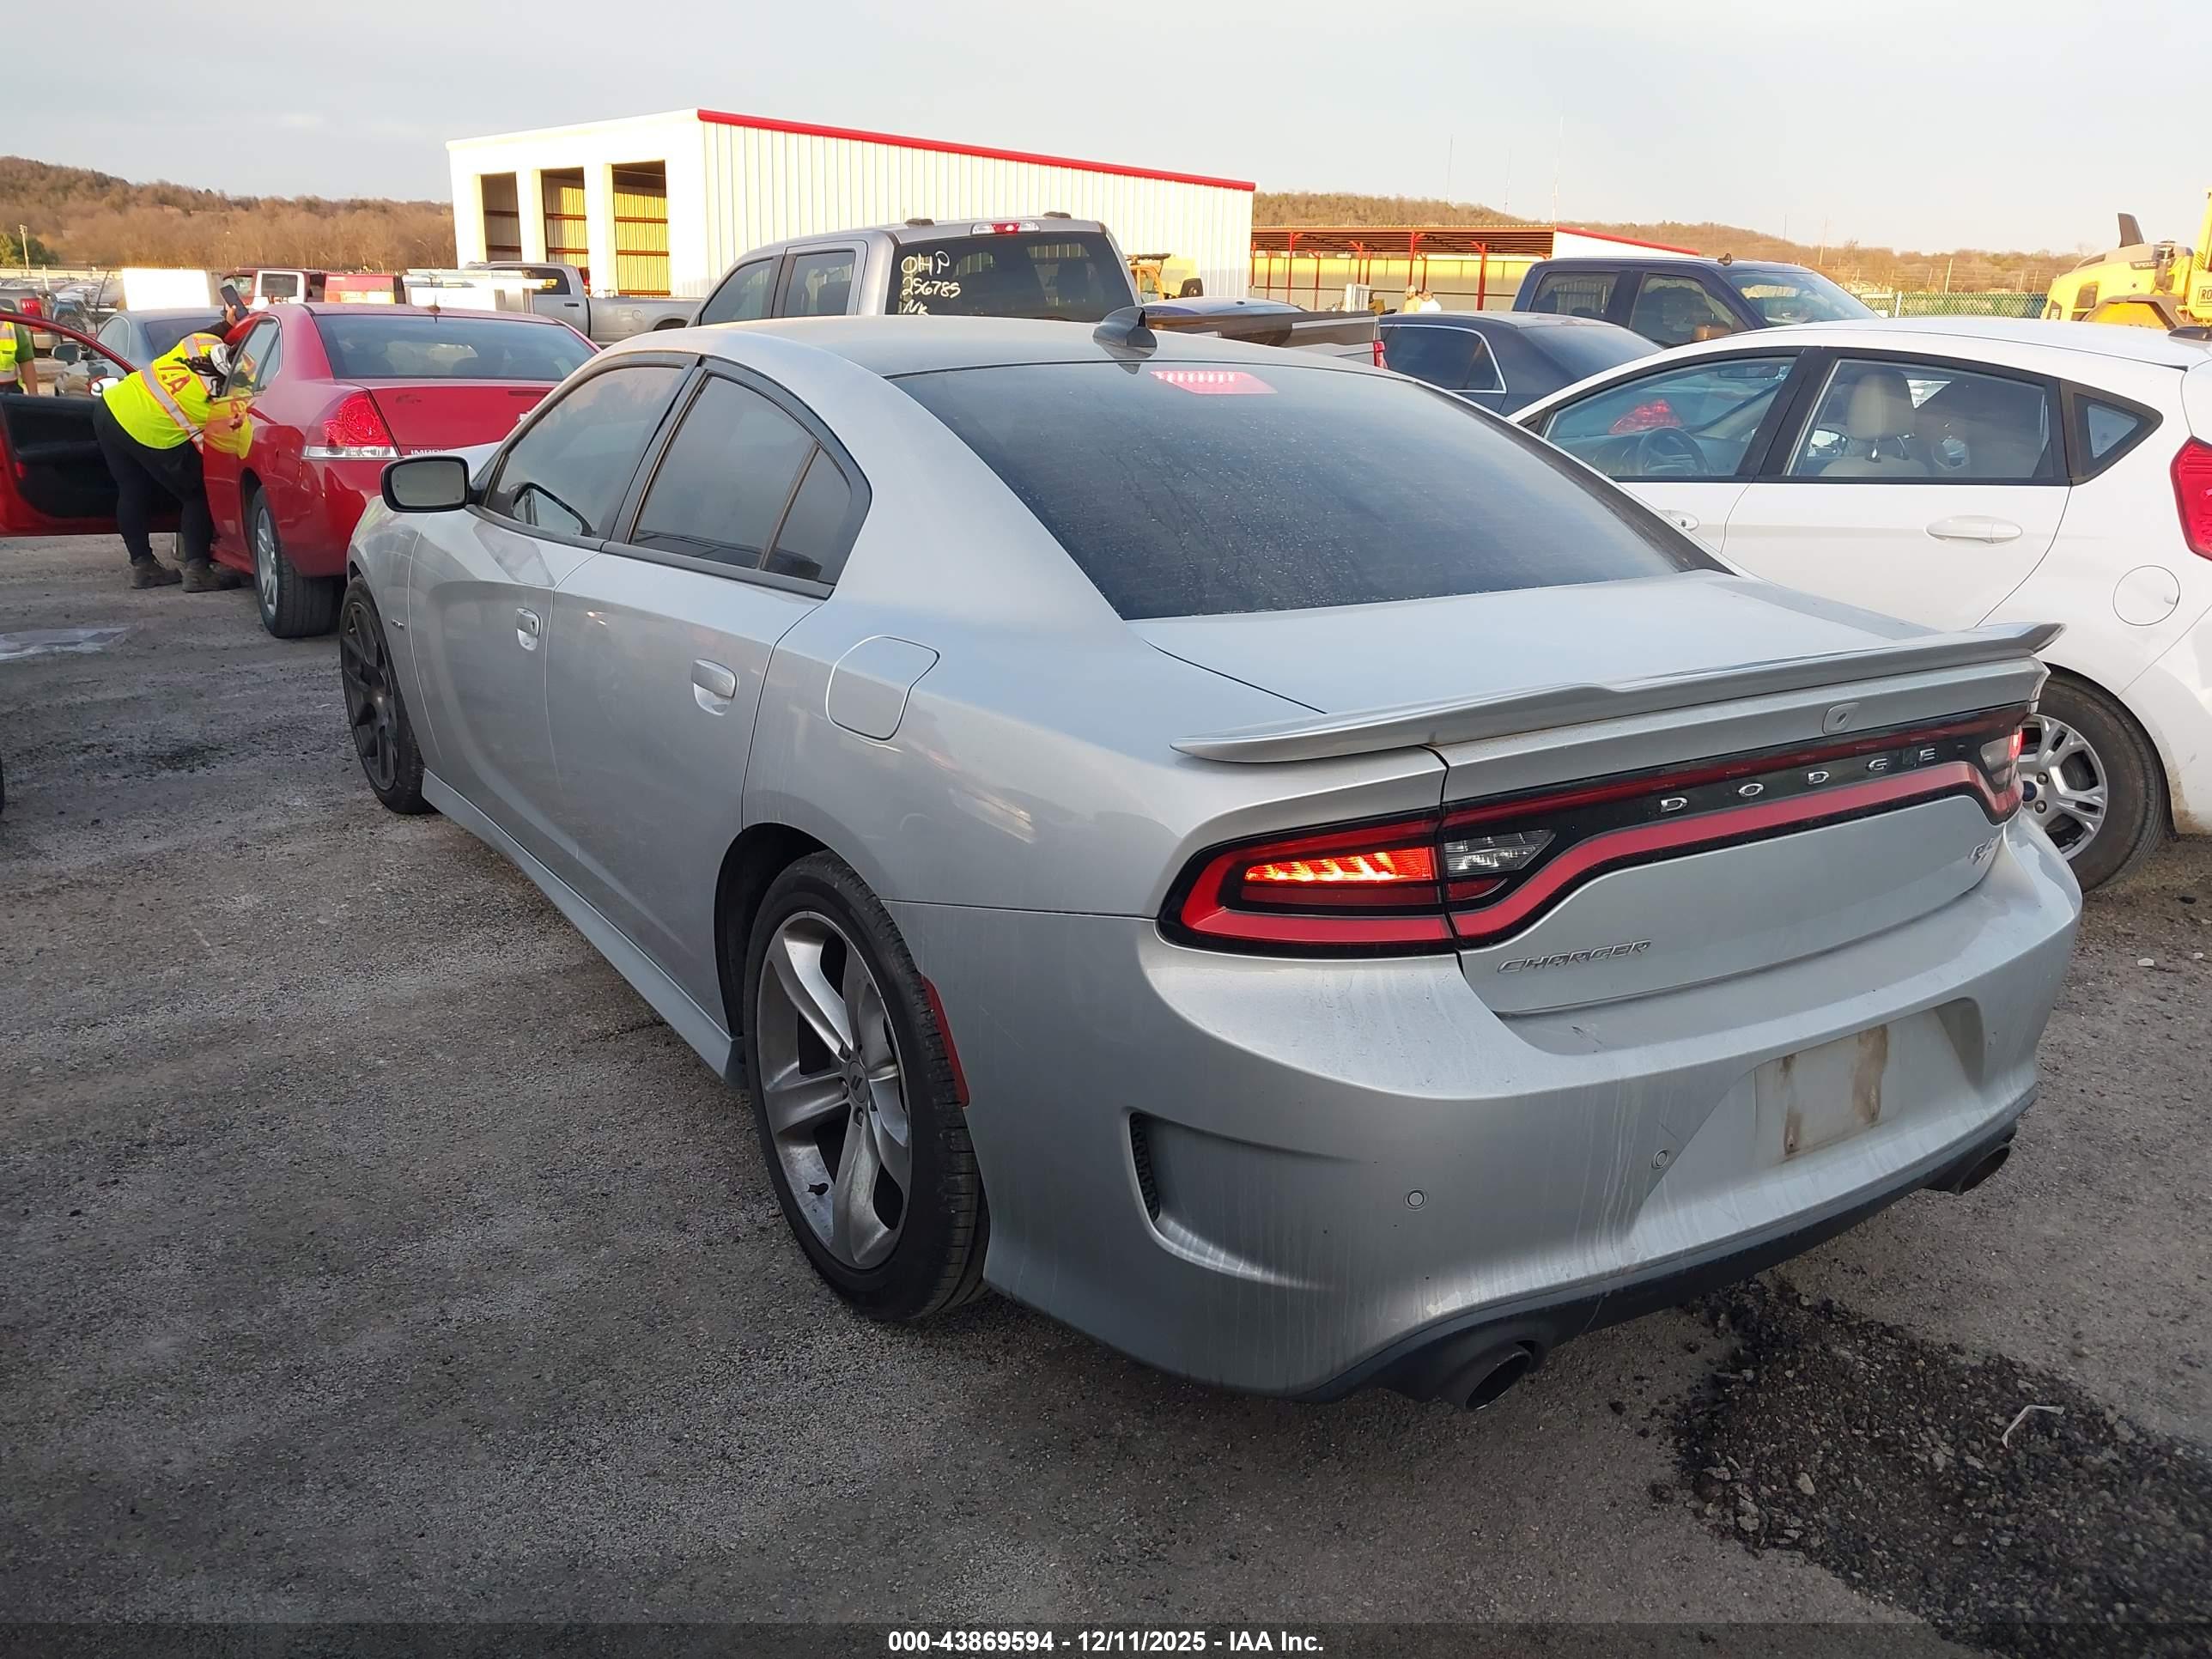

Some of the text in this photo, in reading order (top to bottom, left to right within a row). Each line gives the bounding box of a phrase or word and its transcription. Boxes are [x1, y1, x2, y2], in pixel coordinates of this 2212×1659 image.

[901, 251, 951, 276] OHP
[902, 276, 961, 298] 256785
[1660, 747, 1936, 812] DODGE
[1497, 939, 1652, 974] CHARGER
